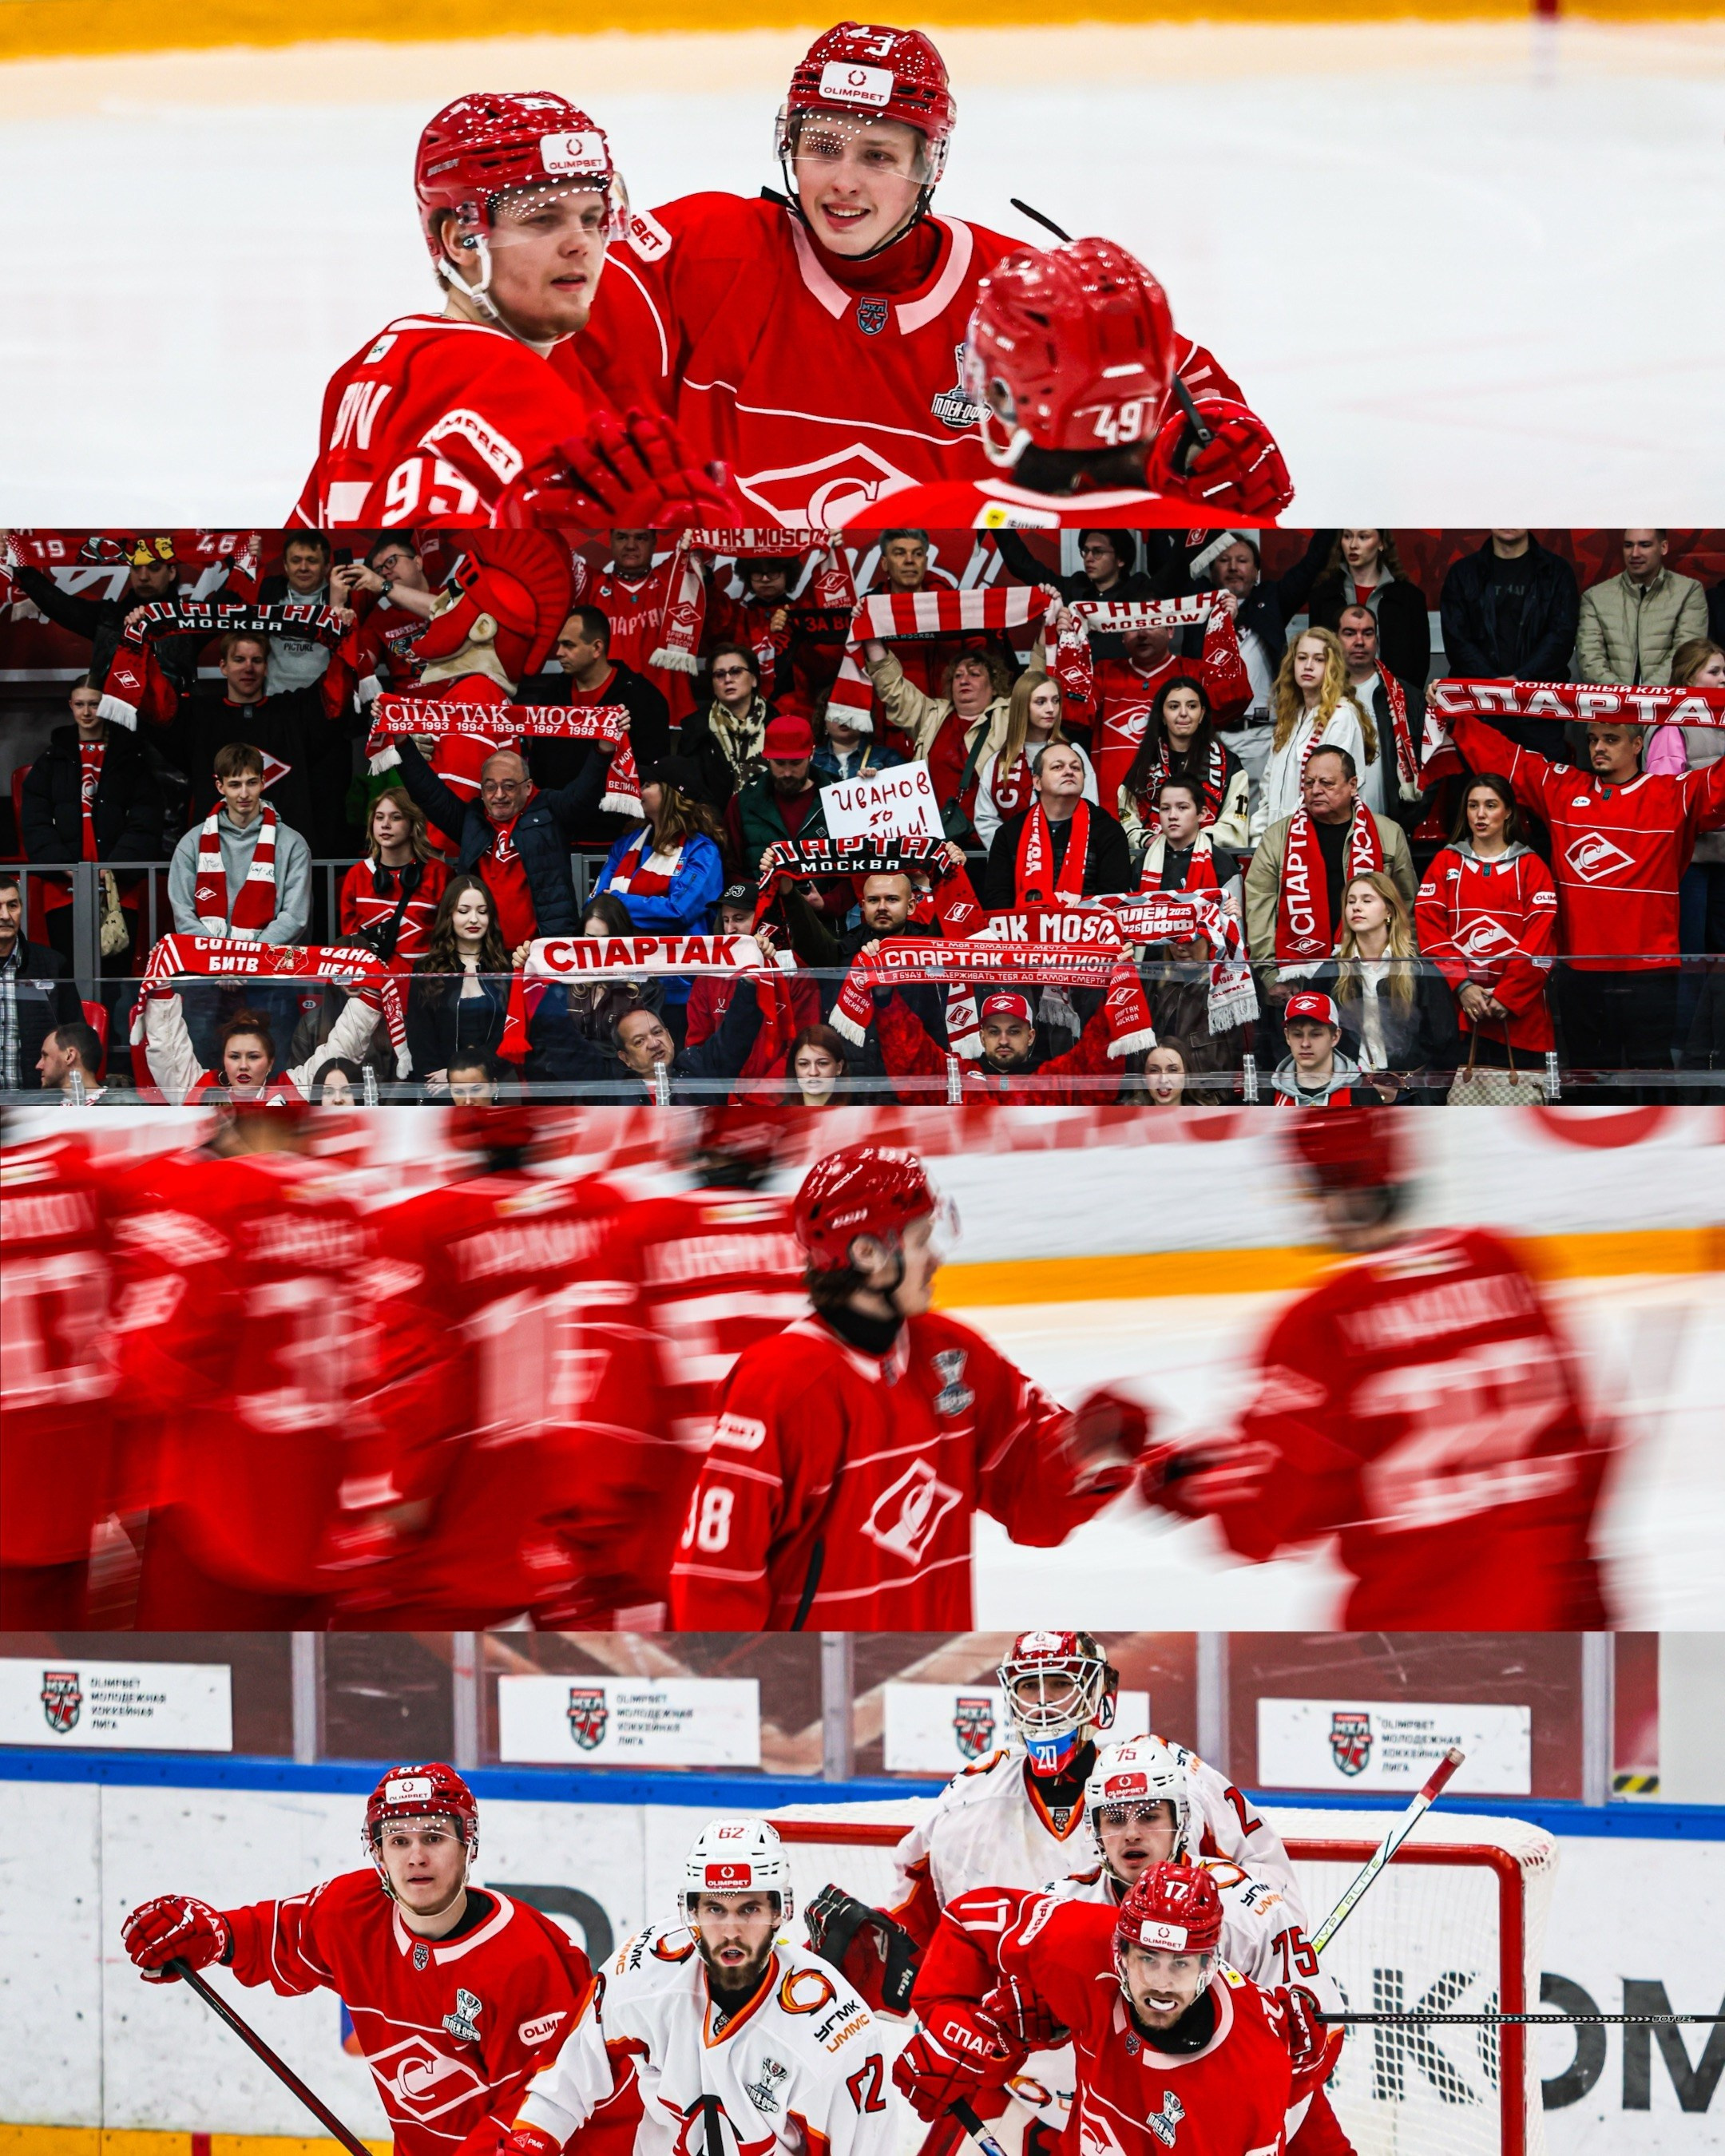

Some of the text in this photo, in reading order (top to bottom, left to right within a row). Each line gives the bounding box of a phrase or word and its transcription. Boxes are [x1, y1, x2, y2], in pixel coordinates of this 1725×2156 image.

[823, 86, 885, 101] OLIMPBET
[549, 159, 603, 170] OLIMPBET
[1093, 402, 1143, 446] 49
[381, 458, 480, 528] 95
[30, 534, 239, 558] 19 46
[177, 618, 283, 631] МОСКВА
[805, 616, 829, 632] ЗА
[1100, 612, 1200, 631] MOSCOW
[284, 642, 314, 652] PICTURE
[1513, 680, 1687, 696] ХОККЕЙНЫЙ КЛУБ
[385, 703, 511, 724] СПАРТАК
[387, 722, 414, 731] 1992
[420, 721, 450, 731] 1993
[456, 722, 485, 732] 1994
[491, 723, 525, 733] 1996
[533, 724, 561, 734] 1997
[568, 726, 596, 735] 1998
[831, 771, 930, 811] ИВАНОВ
[869, 810, 893, 827] 50
[801, 859, 899, 873] МОСКВА
[1286, 802, 1315, 935] СПАРТАК
[1116, 903, 1192, 923] ПЛЕЙ 2025
[1140, 918, 1194, 935] ОФФ
[543, 936, 741, 972] СПАРТАК
[885, 950, 1112, 973] СПАРТАК ЧЕМПИОН
[208, 956, 259, 973] БИТВ
[1071, 975, 1105, 985] СМЕРТИ
[1116, 1748, 1137, 1762] 75
[1107, 1787, 1146, 1797] OLIMPBET
[719, 1826, 745, 1840] 62
[1165, 1881, 1189, 1900] 17
[959, 1898, 1011, 1932] 17
[1142, 1937, 1182, 1949] OLIMPBET
[1271, 1925, 1320, 1984] 75
[813, 1999, 861, 2043] УГМК
[825, 2012, 870, 2054] UMMC
[942, 2020, 997, 2056] СПАР
[1330, 1966, 1725, 2114] КОМ
